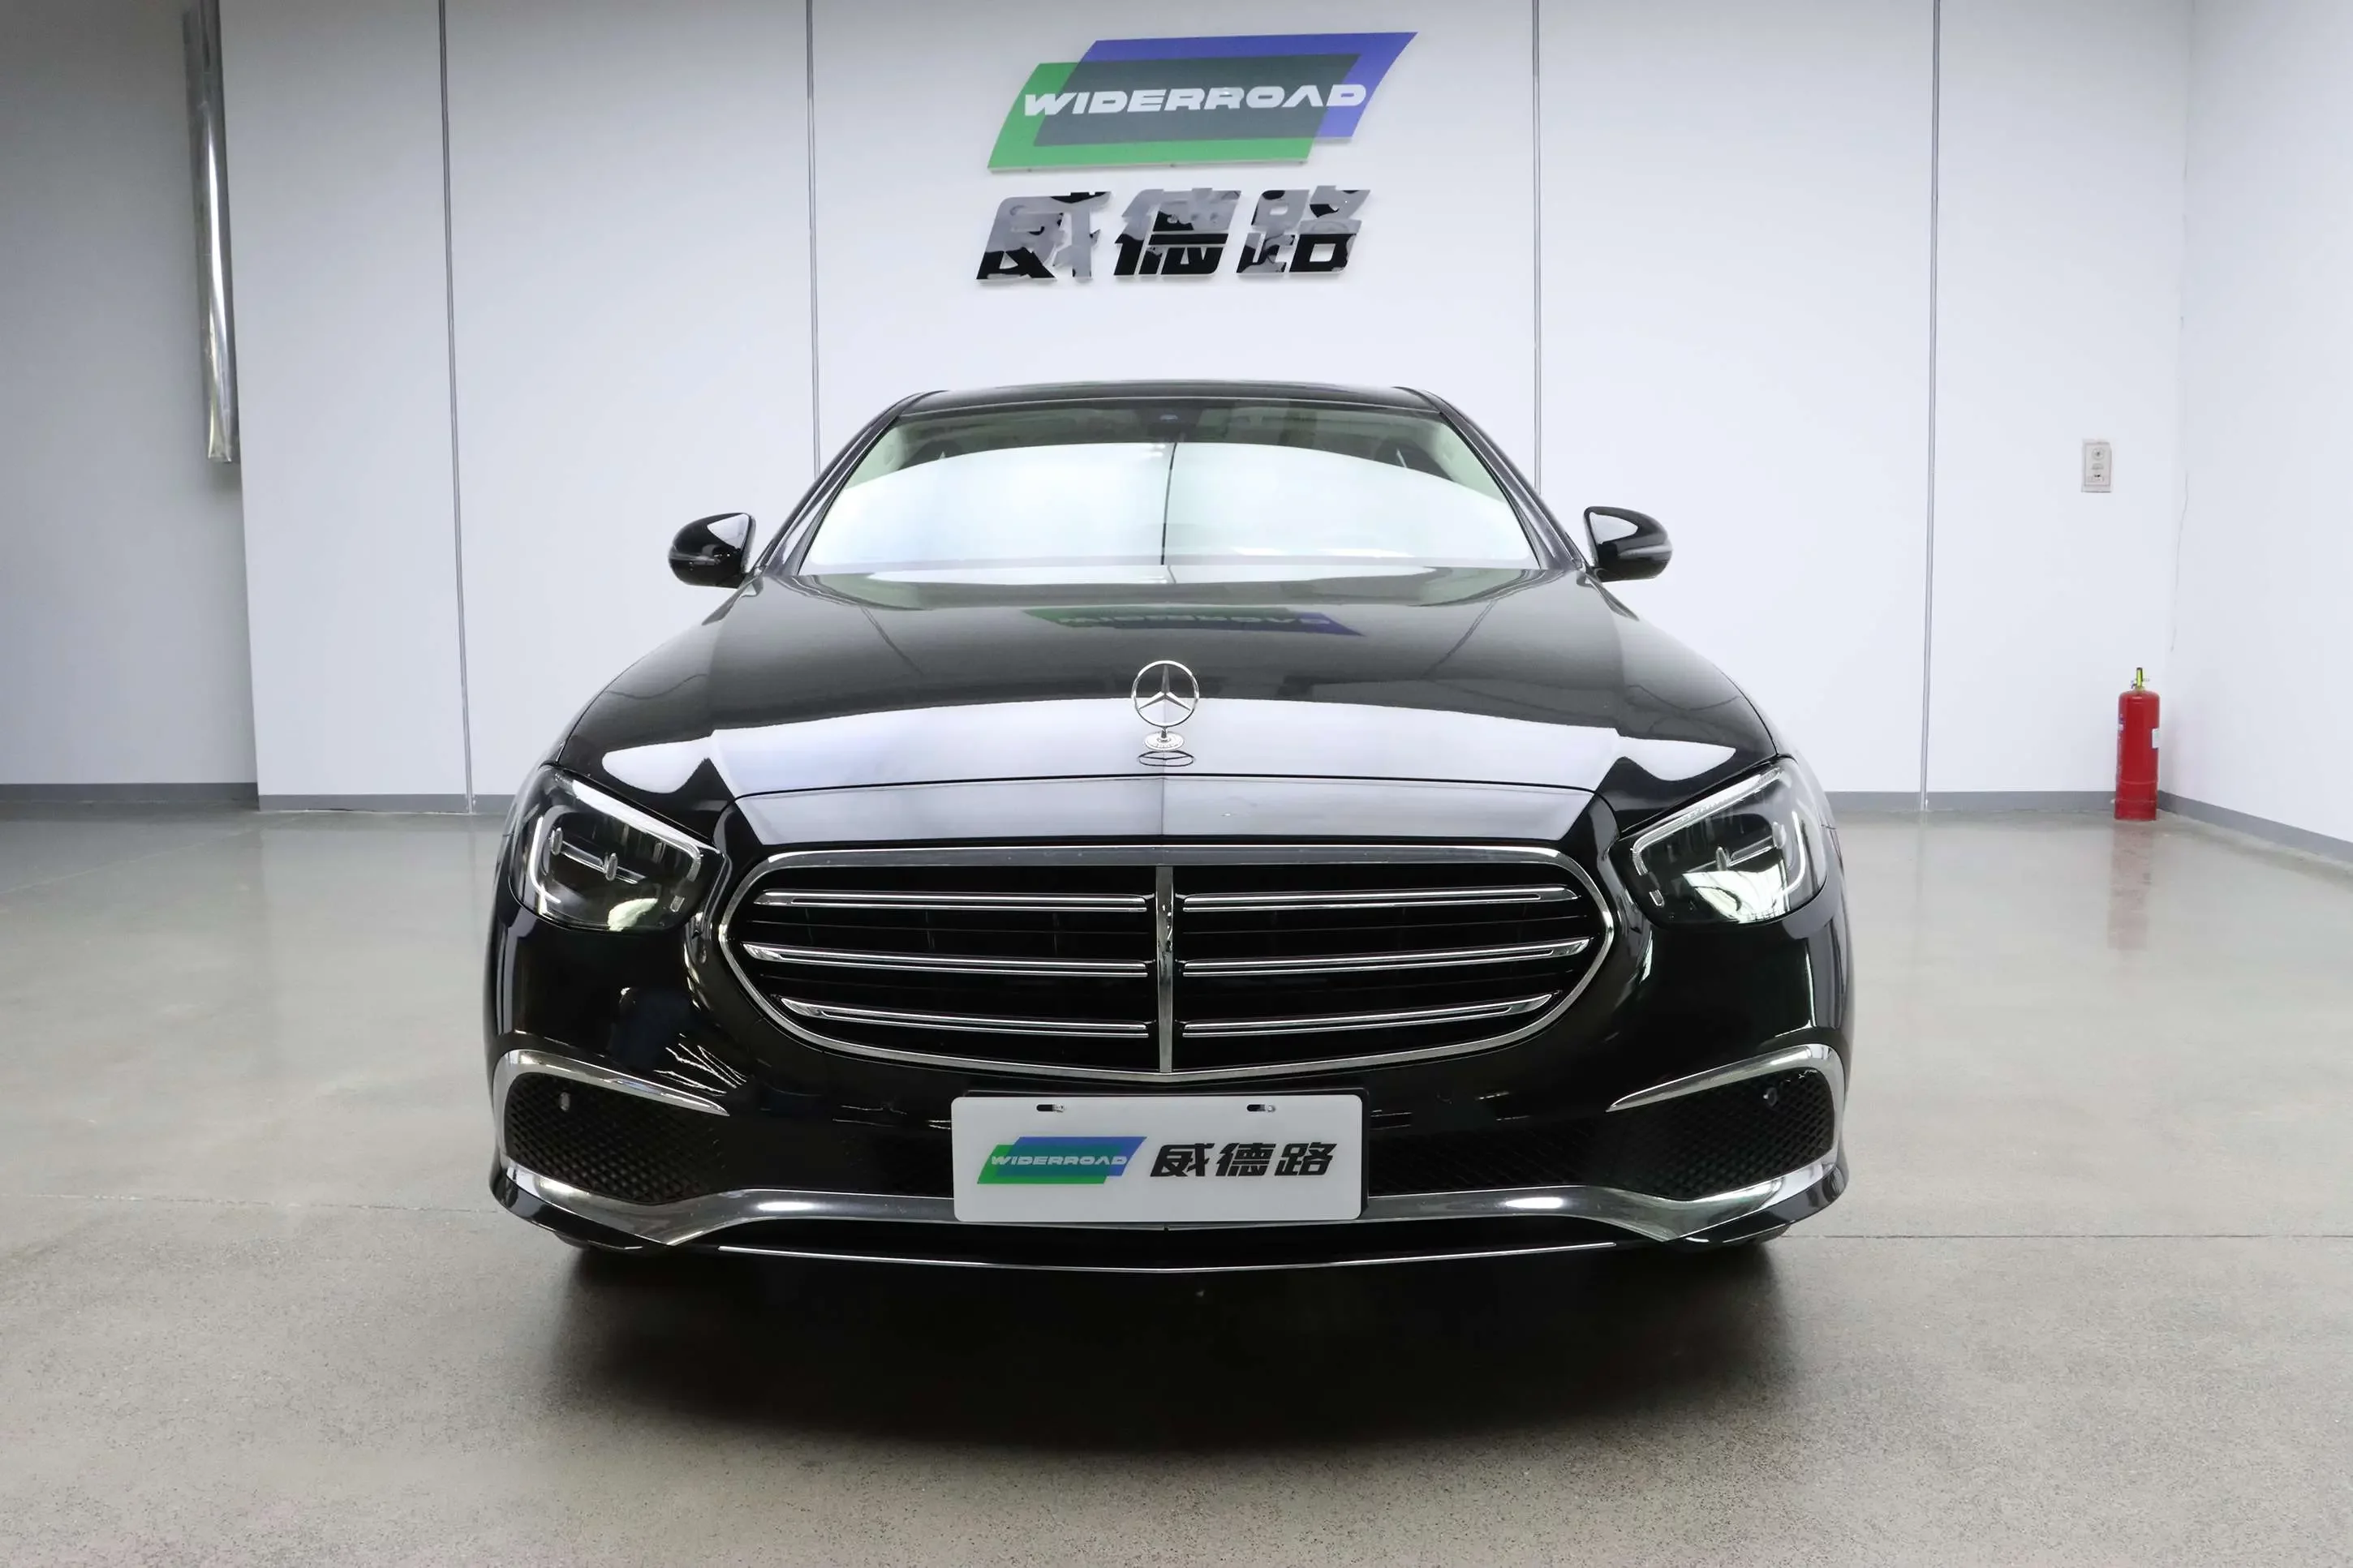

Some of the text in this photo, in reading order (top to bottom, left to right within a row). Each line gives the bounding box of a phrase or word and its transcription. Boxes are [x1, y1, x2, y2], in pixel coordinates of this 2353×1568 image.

[1024, 84, 1367, 116] WIDERROAD
[976, 186, 1371, 280] 威德路
[991, 1155, 1128, 1166] WIDERROAD
[1150, 1142, 1338, 1178] 威德路
